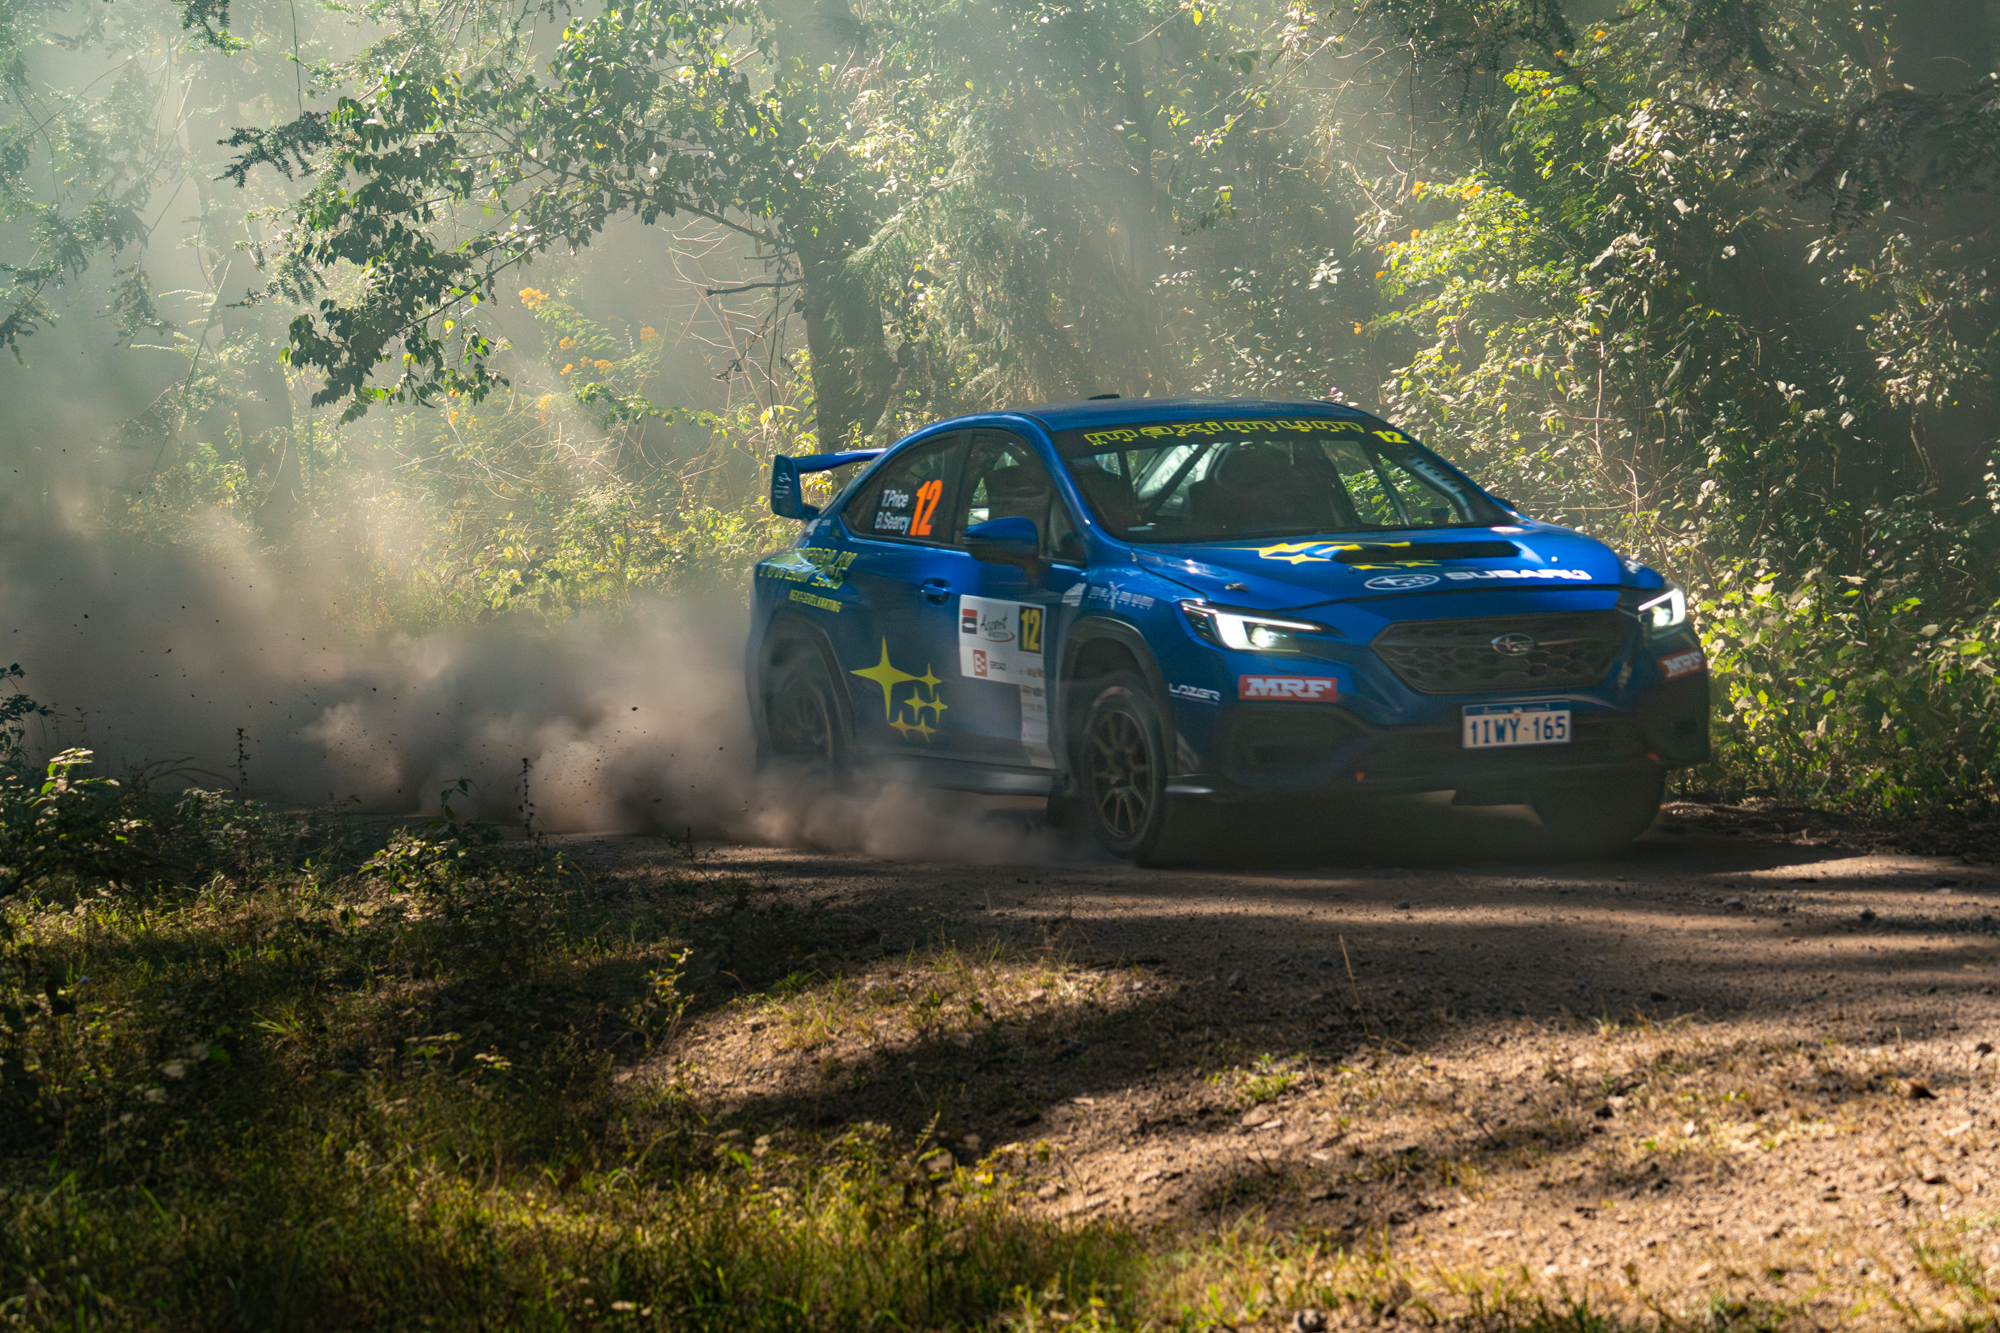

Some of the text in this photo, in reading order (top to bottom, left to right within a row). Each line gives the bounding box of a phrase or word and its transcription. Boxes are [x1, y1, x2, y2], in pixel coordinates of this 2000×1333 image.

[1371, 430, 1410, 444] 12
[881, 489, 909, 508] T.Price
[909, 479, 943, 536] 12
[874, 511, 912, 535] B.Searcy
[1445, 569, 1592, 580] SUBARU
[1021, 608, 1041, 651] 12
[1244, 677, 1332, 698] MRF
